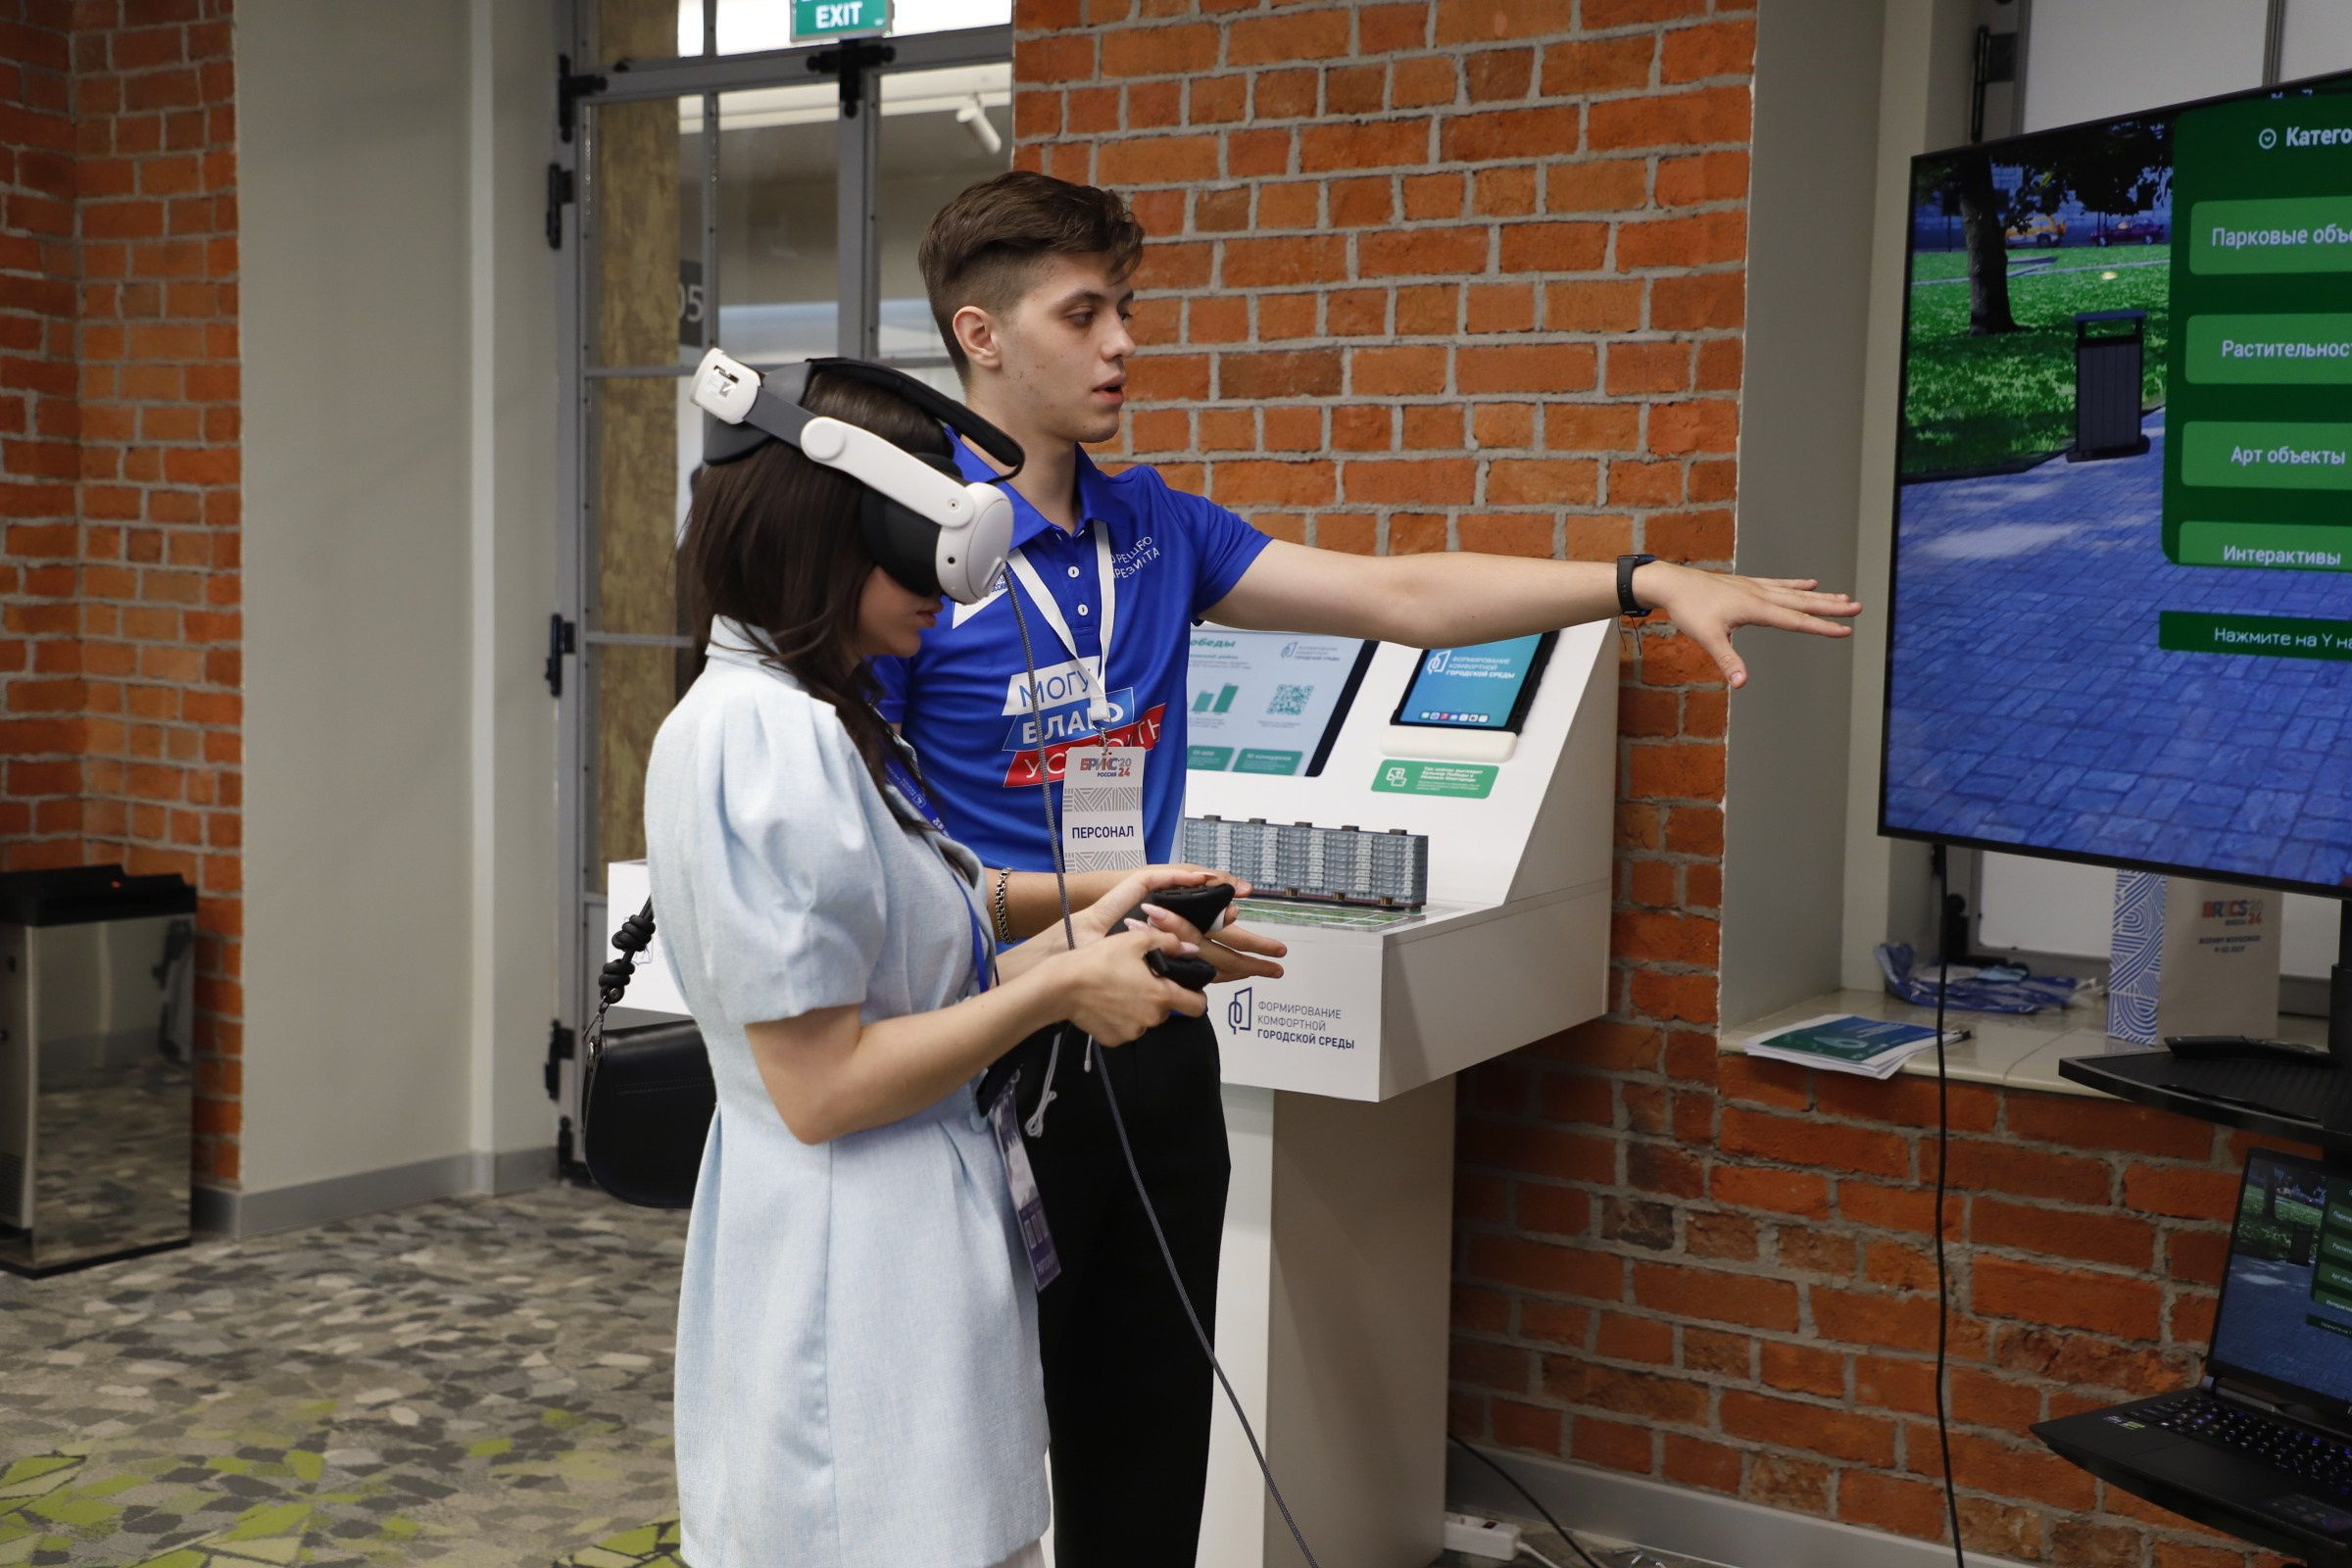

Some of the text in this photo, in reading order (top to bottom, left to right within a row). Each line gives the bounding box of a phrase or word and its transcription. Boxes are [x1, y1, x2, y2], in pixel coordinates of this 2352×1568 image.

[815, 2, 863, 29] EXIT
[2285, 125, 2352, 147] Катего
[2212, 227, 2308, 251] Парковые
[2222, 340, 2352, 359] Растительнос
[2230, 446, 2346, 466] Арт объекты
[2223, 545, 2341, 567] Интерактивы
[2215, 627, 2291, 646] Нажмите
[2295, 633, 2318, 648] на
[1117, 767, 1130, 777] 24
[1072, 825, 1134, 840] ПЕРСОНАЛ
[1258, 1001, 1342, 1019] ФОРМИРОВАНИЕ
[1257, 1014, 1326, 1032] КОМФОРТНОЙ
[1257, 1029, 1355, 1050] ГОРОДСКОЙ СРЕДЫ
